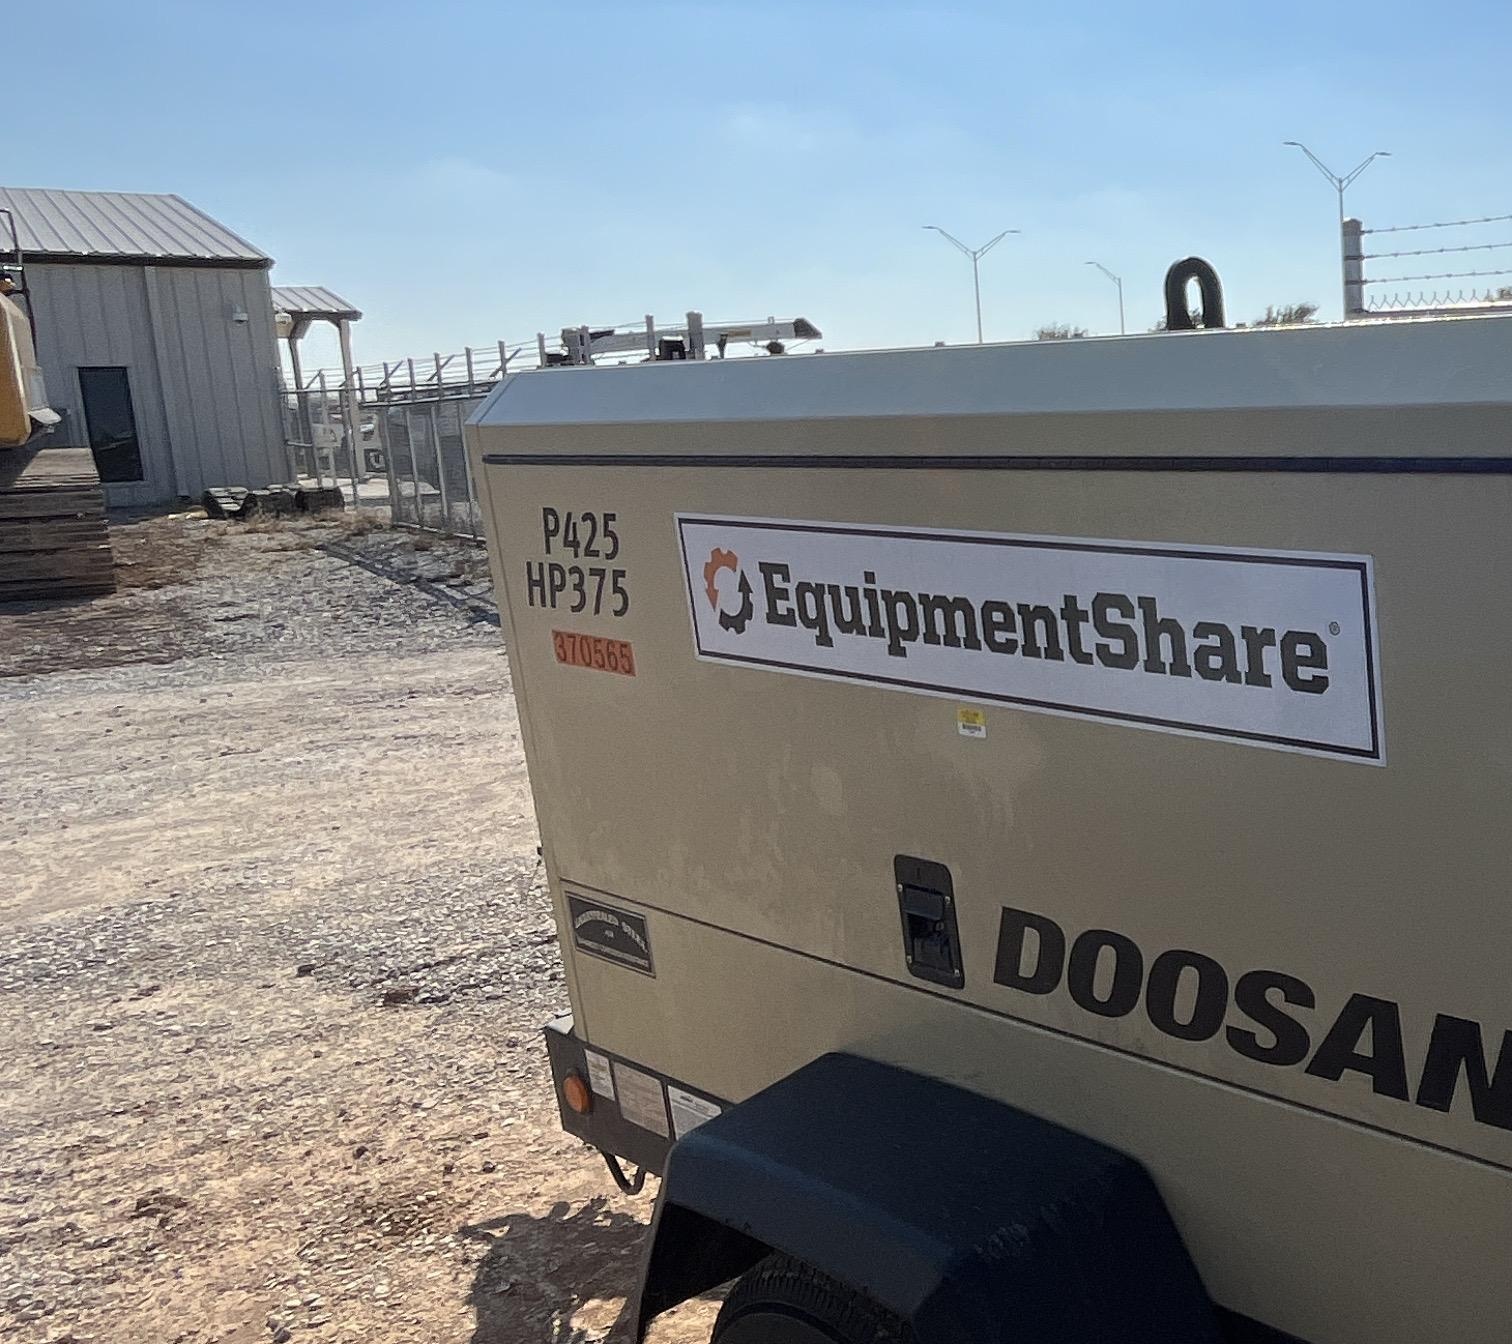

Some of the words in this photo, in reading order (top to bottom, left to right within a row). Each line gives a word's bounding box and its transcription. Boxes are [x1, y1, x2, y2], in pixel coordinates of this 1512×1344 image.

[542, 507, 620, 561] P425
[526, 560, 630, 618] HP375
[553, 630, 633, 675] 370565
[757, 560, 1331, 695] EquipmentShare
